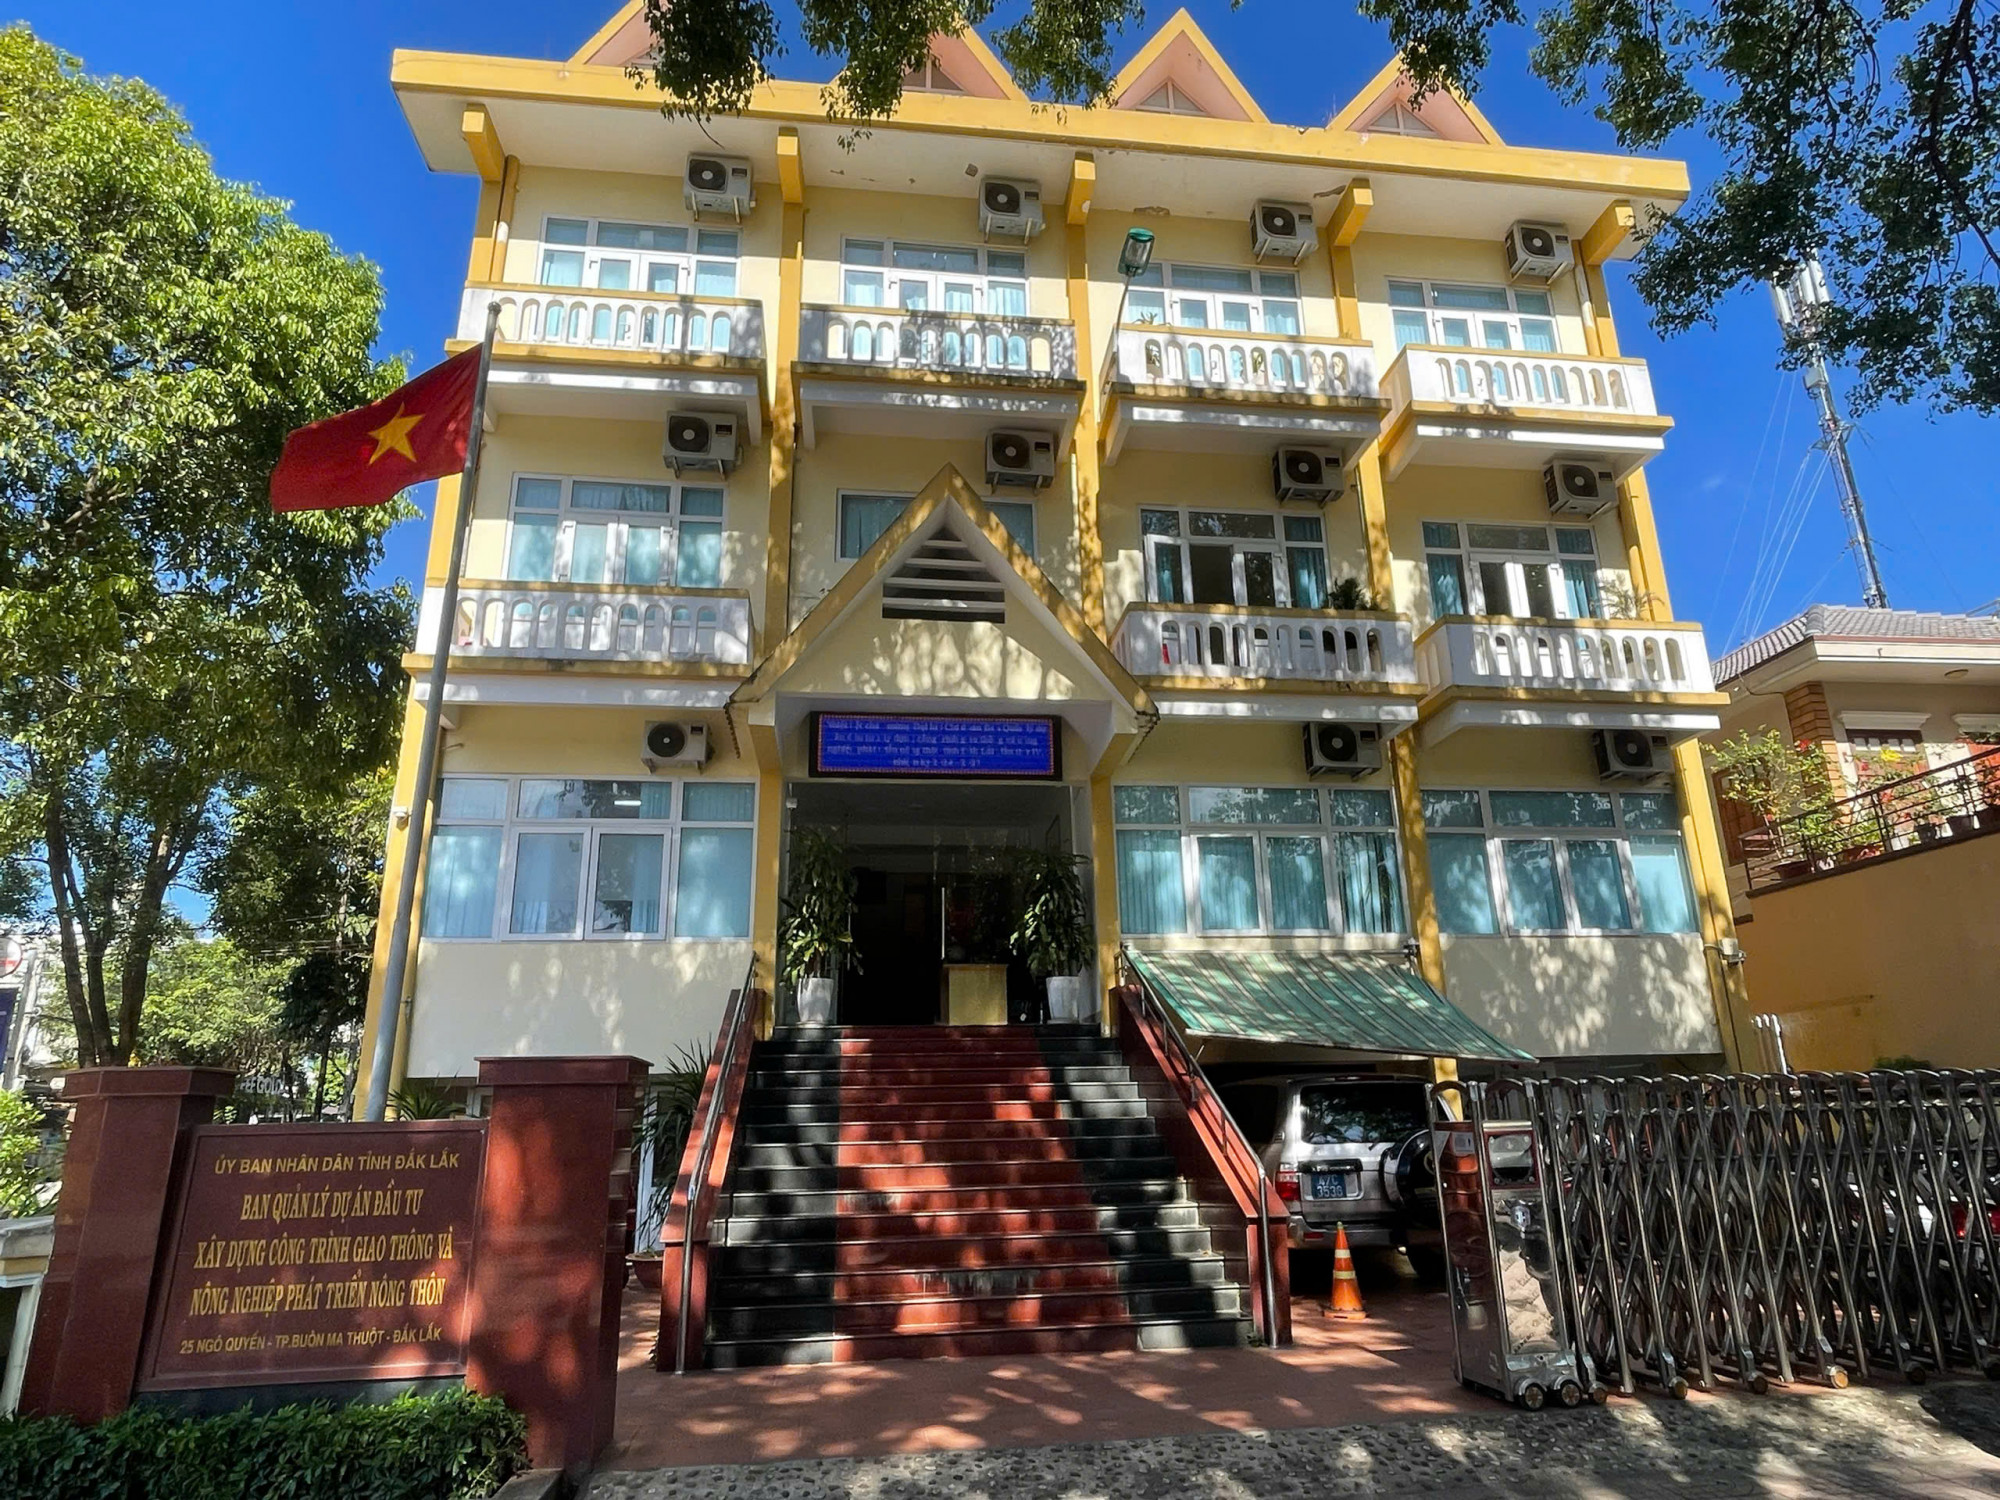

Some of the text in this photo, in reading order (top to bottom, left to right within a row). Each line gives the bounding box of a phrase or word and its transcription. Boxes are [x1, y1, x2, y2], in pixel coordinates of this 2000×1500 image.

[239, 1158, 273, 1175] BAN
[275, 1153, 319, 1173] NHÂN
[321, 1152, 354, 1172] DÂN
[394, 1147, 427, 1171] ĐẮK
[429, 1146, 460, 1169] LẮK
[240, 1177, 424, 1225] BAN QUẢN LÝ DỰ ÁN ĐẦU TƯ
[193, 1225, 454, 1275] XÂY DỰNG CÔNG TRÌNH GIAO THÔNG VÀ
[188, 1268, 446, 1319] NÔNG NGHIỆP PHÁT TRIỂN NÔNG THÔN
[179, 1339, 195, 1355] 25
[326, 1332, 344, 1347] MA
[347, 1326, 385, 1348] THUỘT
